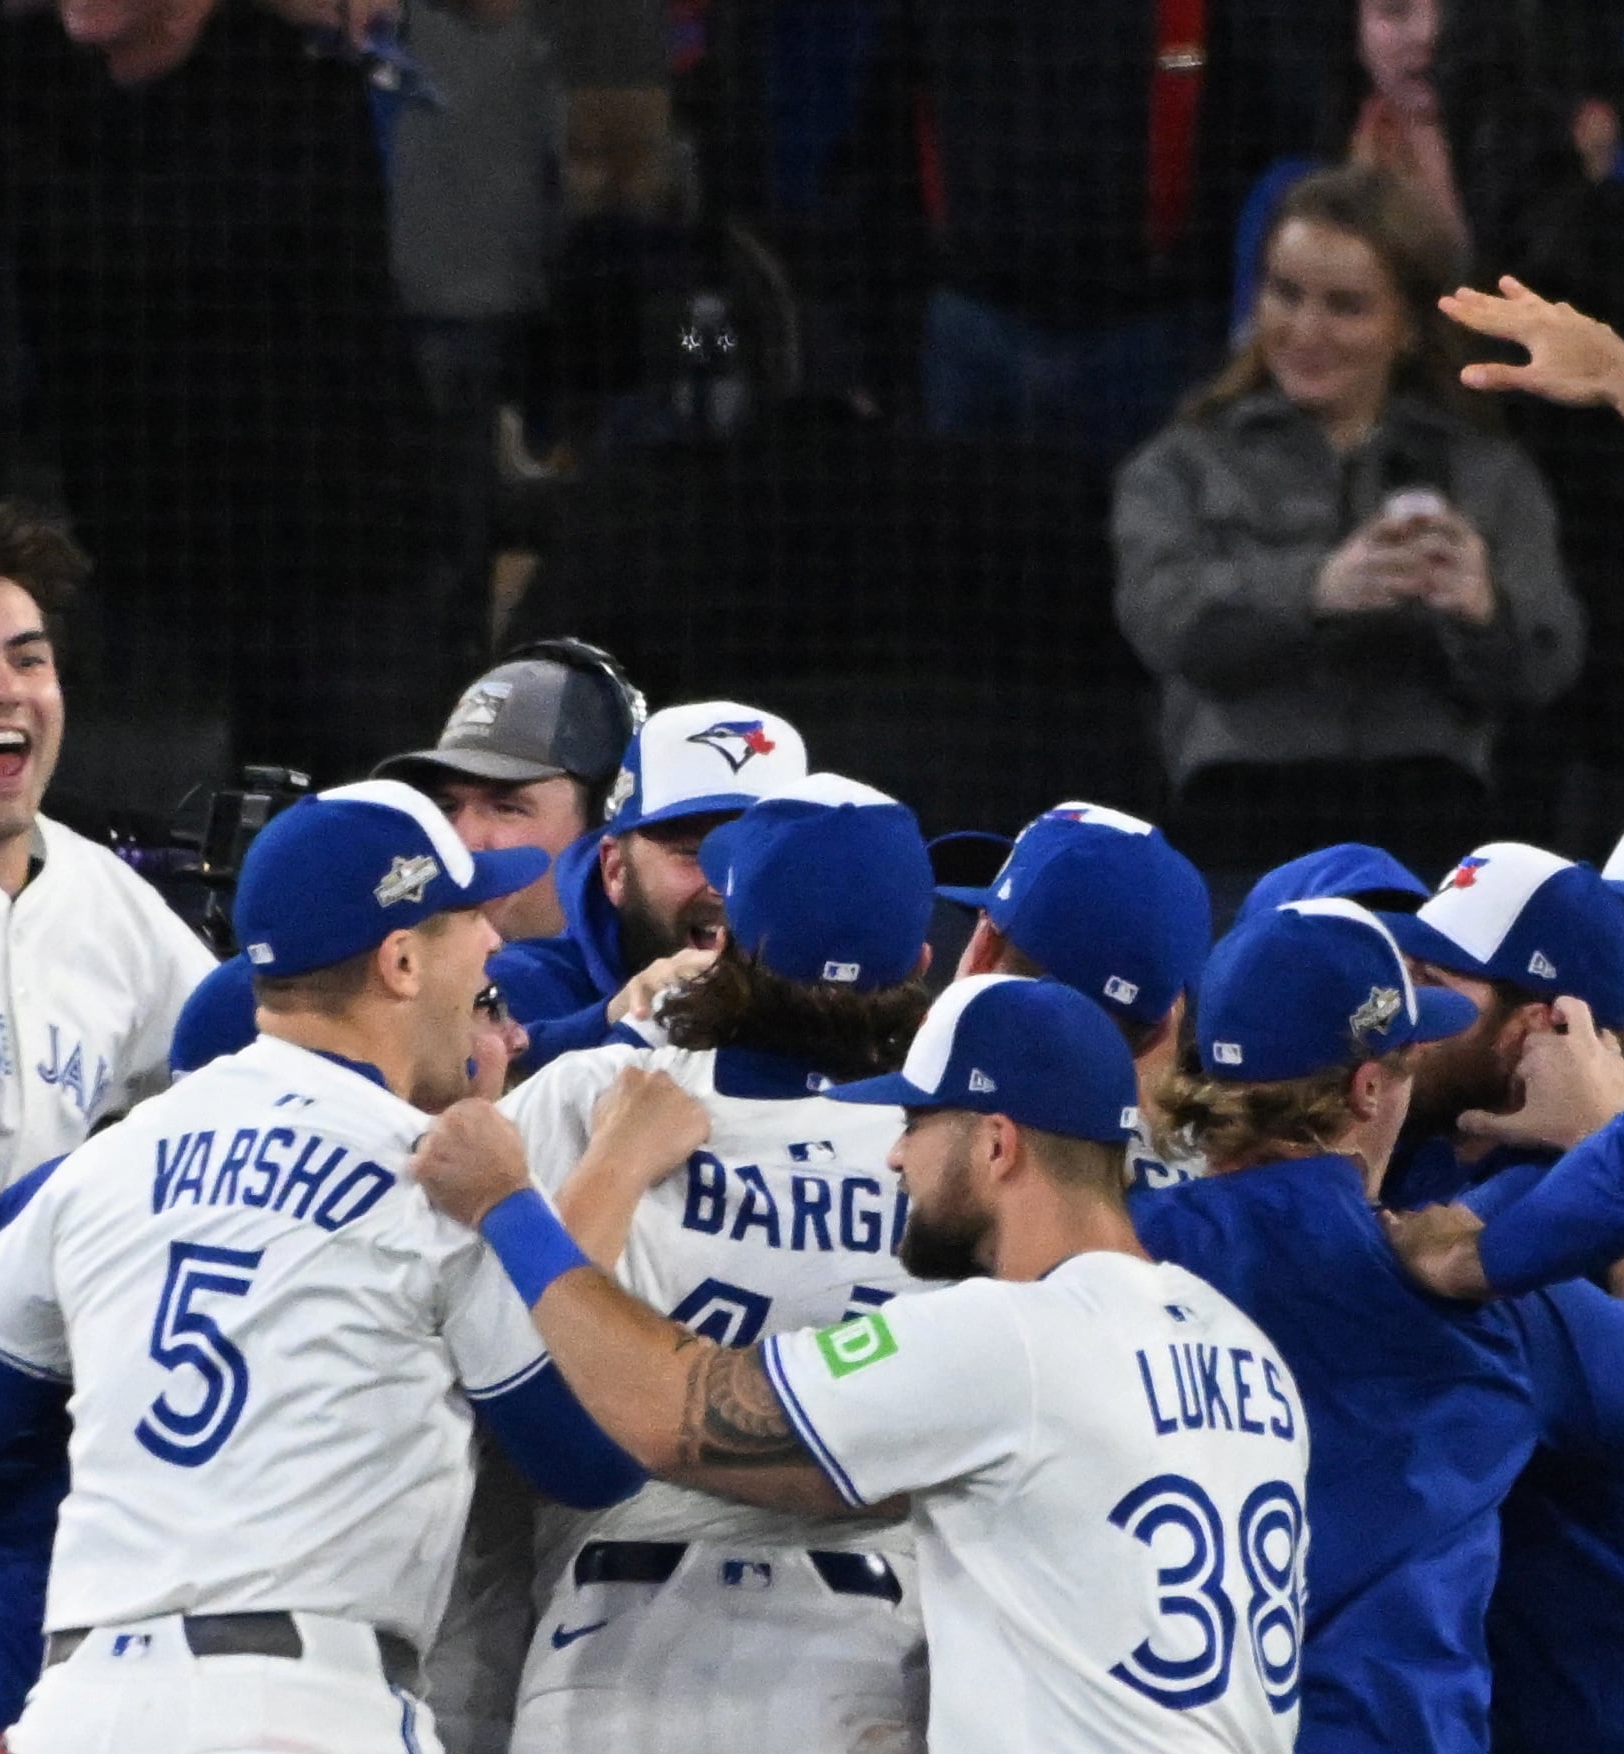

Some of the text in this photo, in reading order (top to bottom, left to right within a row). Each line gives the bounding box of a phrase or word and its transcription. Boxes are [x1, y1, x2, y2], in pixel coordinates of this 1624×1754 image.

[153, 1127, 397, 1232] VARSHO
[135, 1240, 266, 1468] 5
[1135, 1343, 1295, 1442] LUKES
[1106, 1474, 1303, 1716] 38
